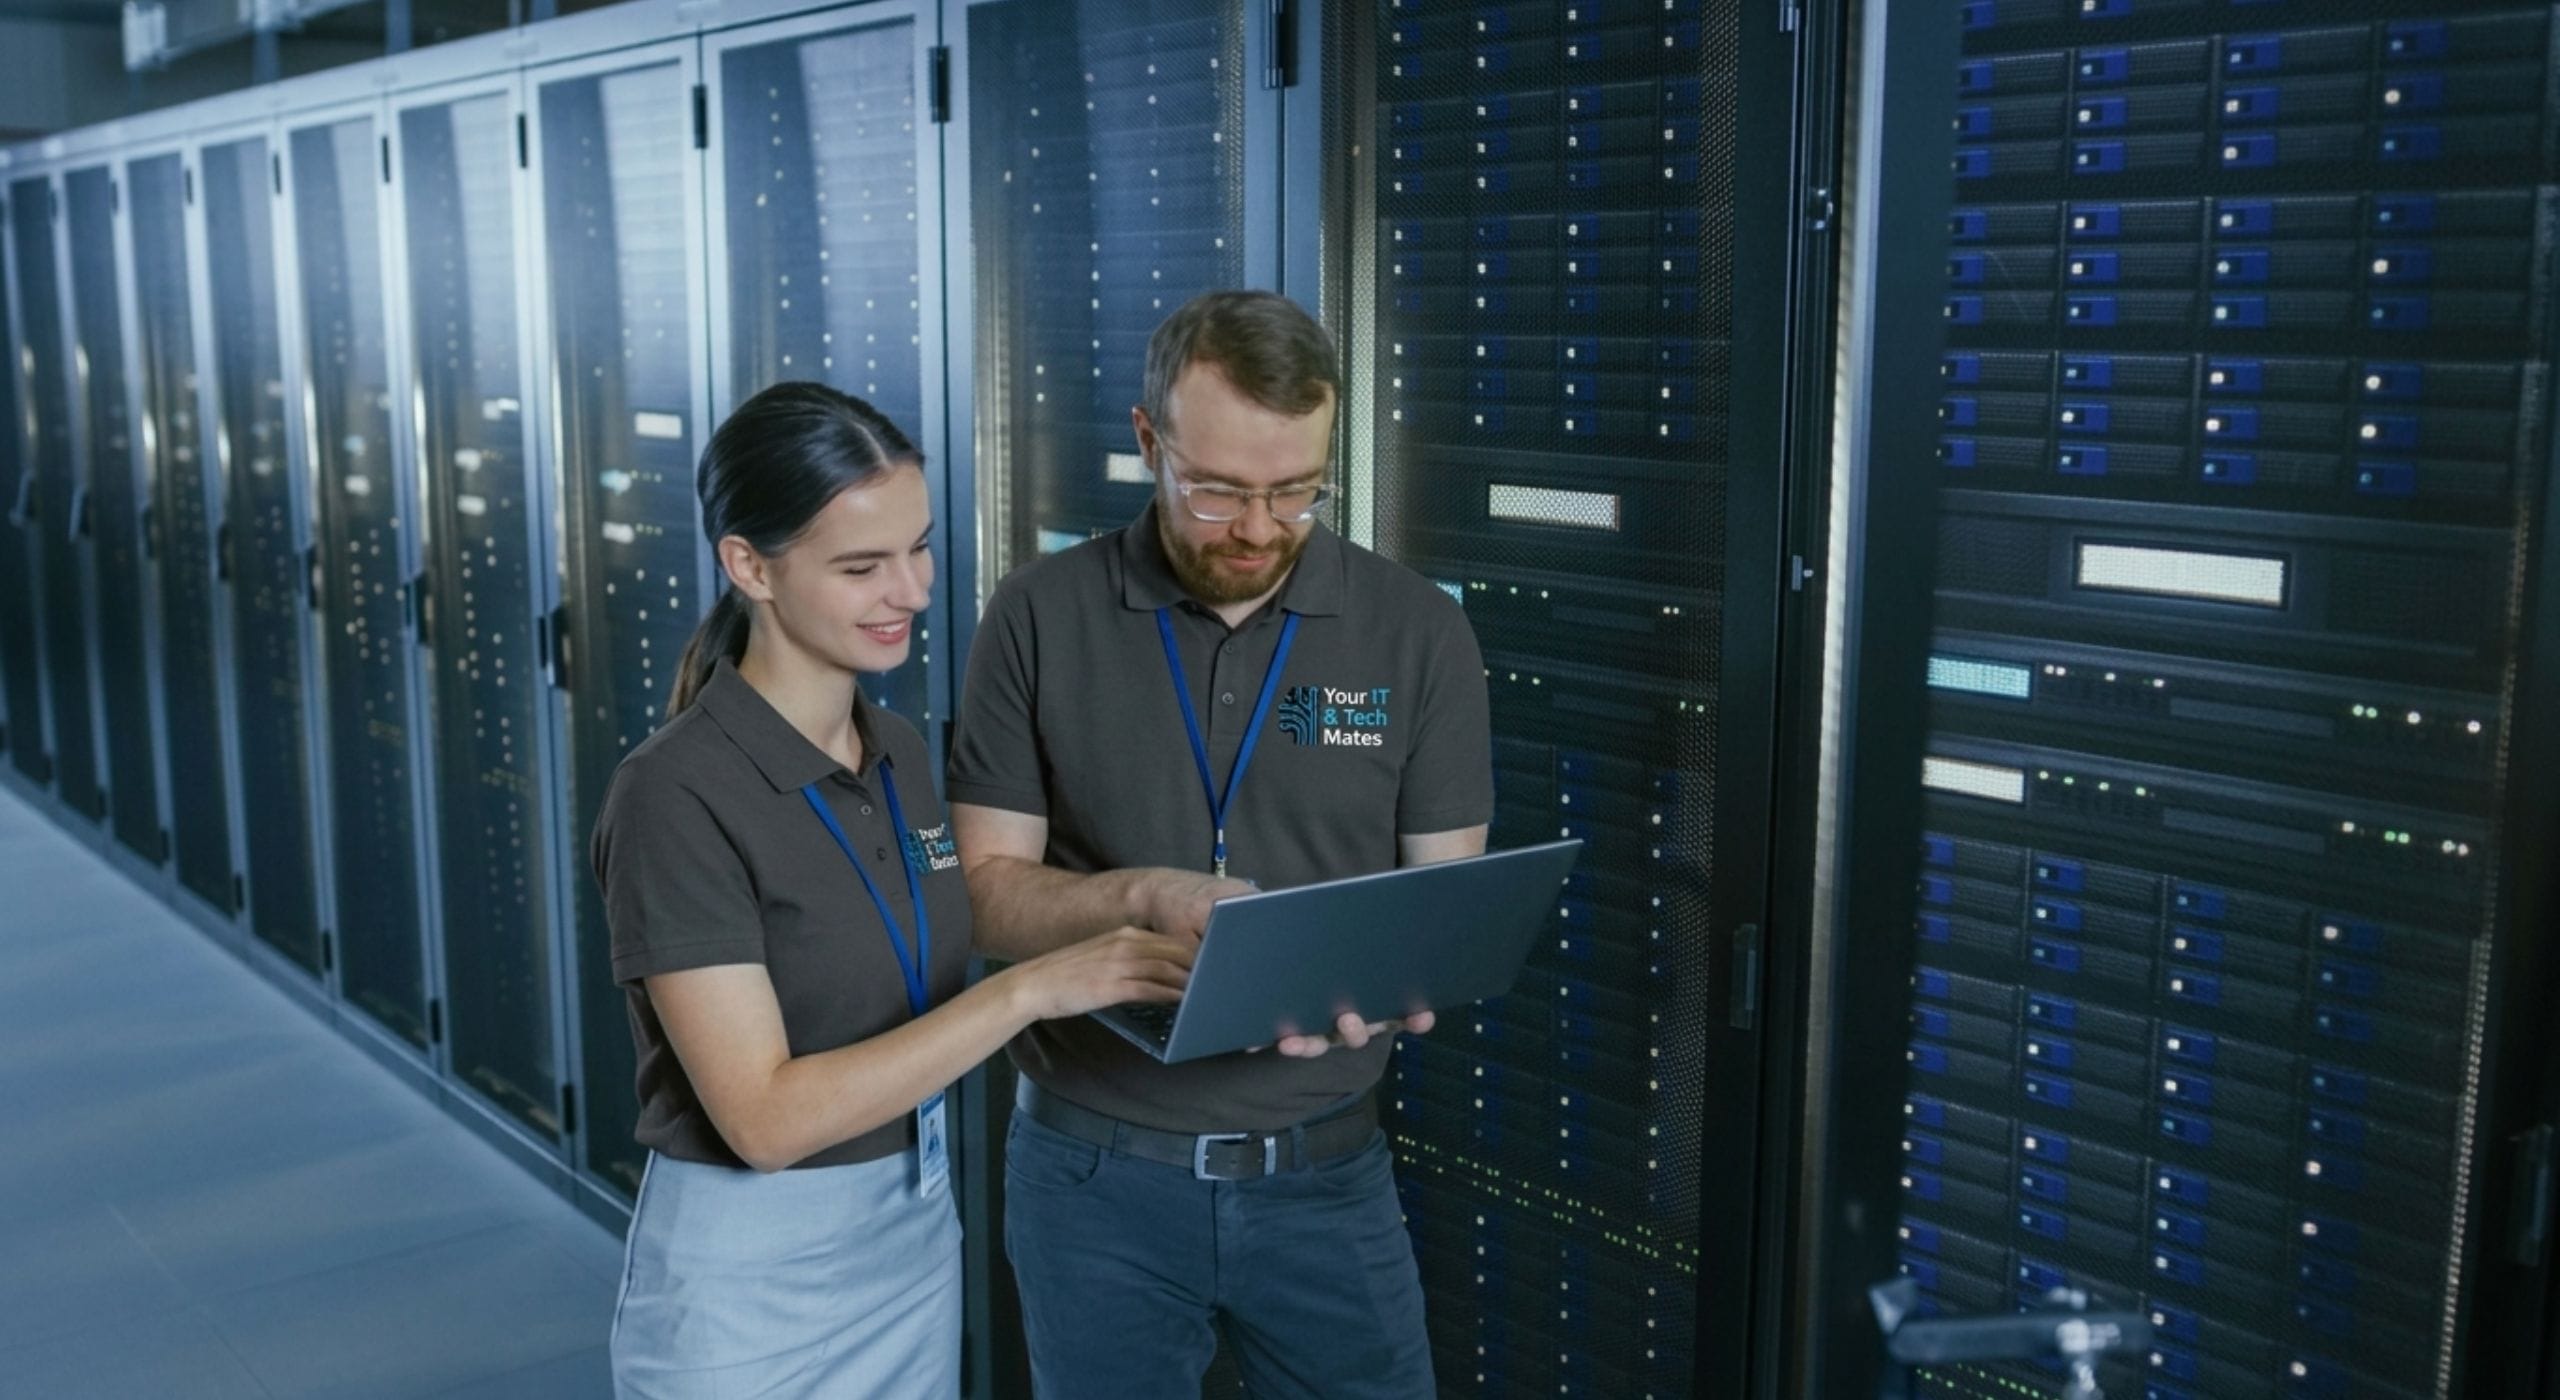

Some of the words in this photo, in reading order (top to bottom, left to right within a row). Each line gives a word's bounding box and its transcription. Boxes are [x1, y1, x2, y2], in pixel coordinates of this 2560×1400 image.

[1323, 687, 1368, 705] Your
[1371, 688, 1390, 705] IT
[1323, 708, 1338, 726] &
[1343, 708, 1387, 726] Tech
[1323, 728, 1383, 746] Mates
